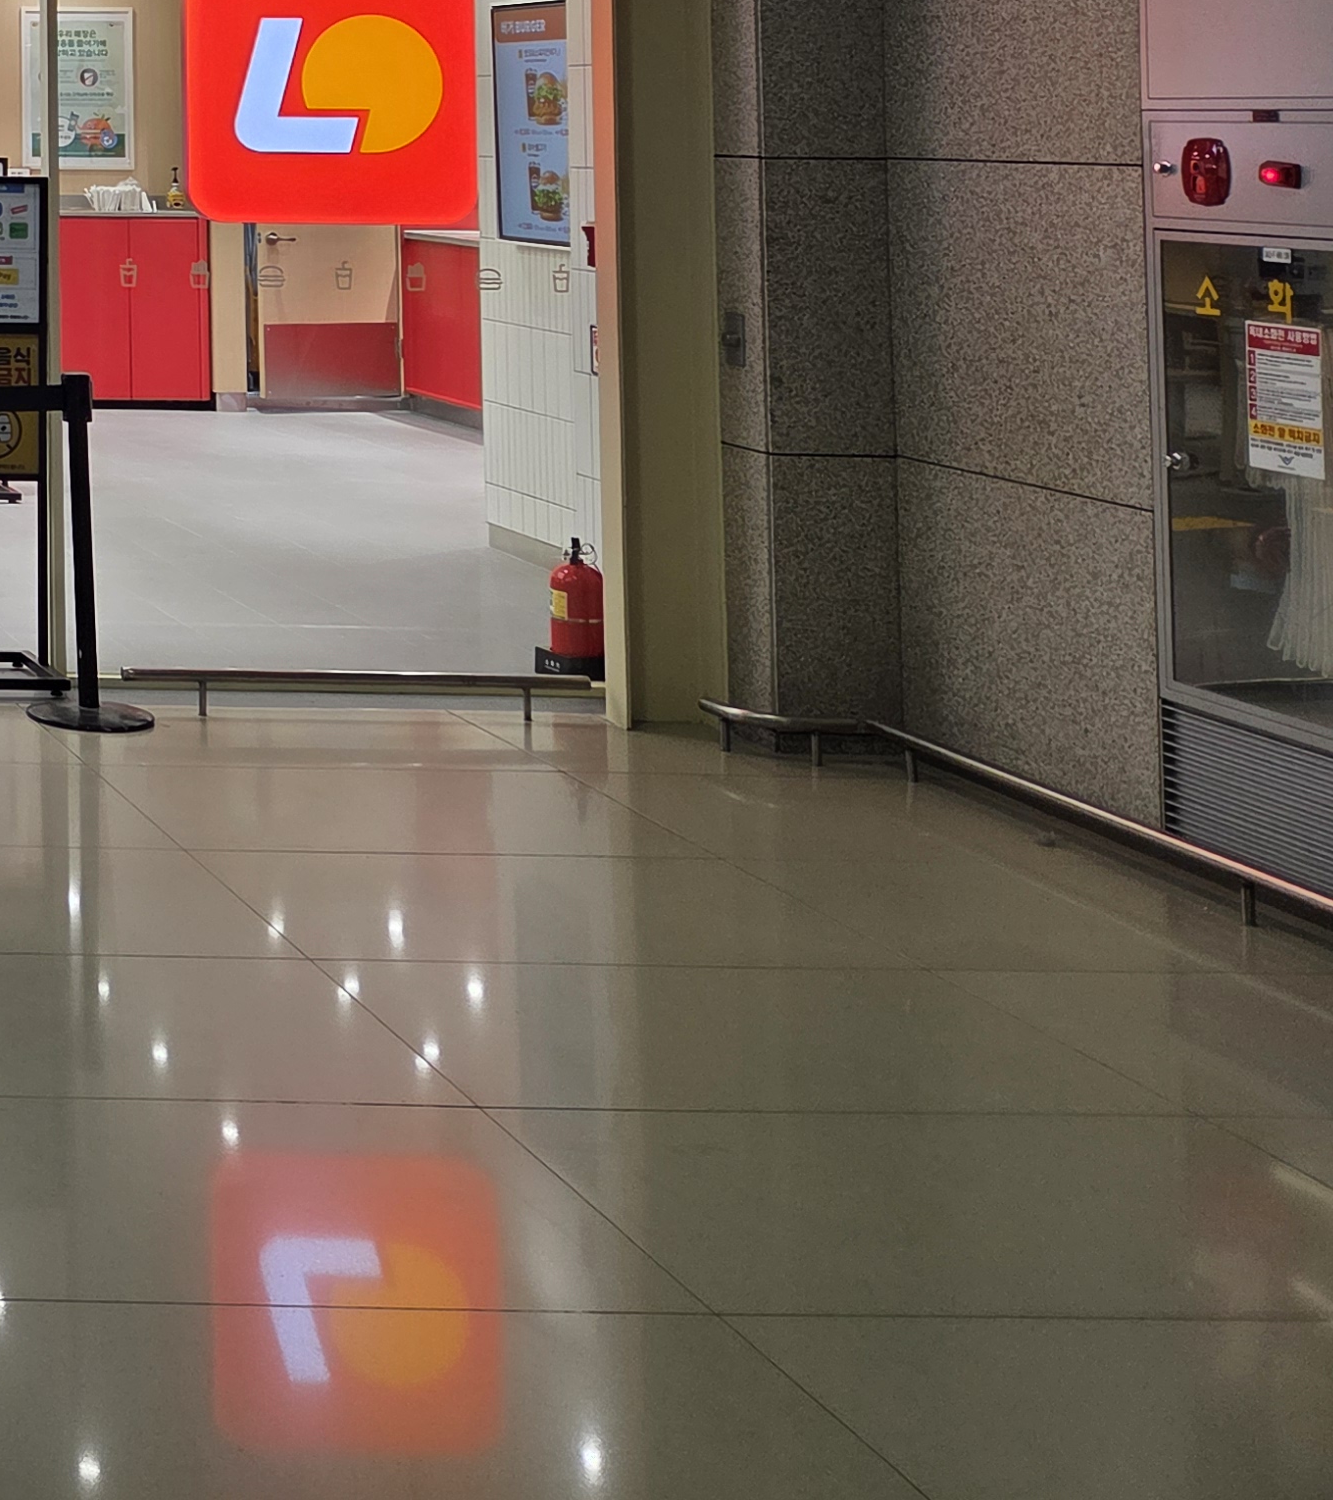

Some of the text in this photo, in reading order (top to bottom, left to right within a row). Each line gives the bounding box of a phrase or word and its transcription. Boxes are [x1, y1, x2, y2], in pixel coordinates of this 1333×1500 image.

[1196, 275, 1294, 324] 소 화
[1252, 424, 1276, 438] 소화전
